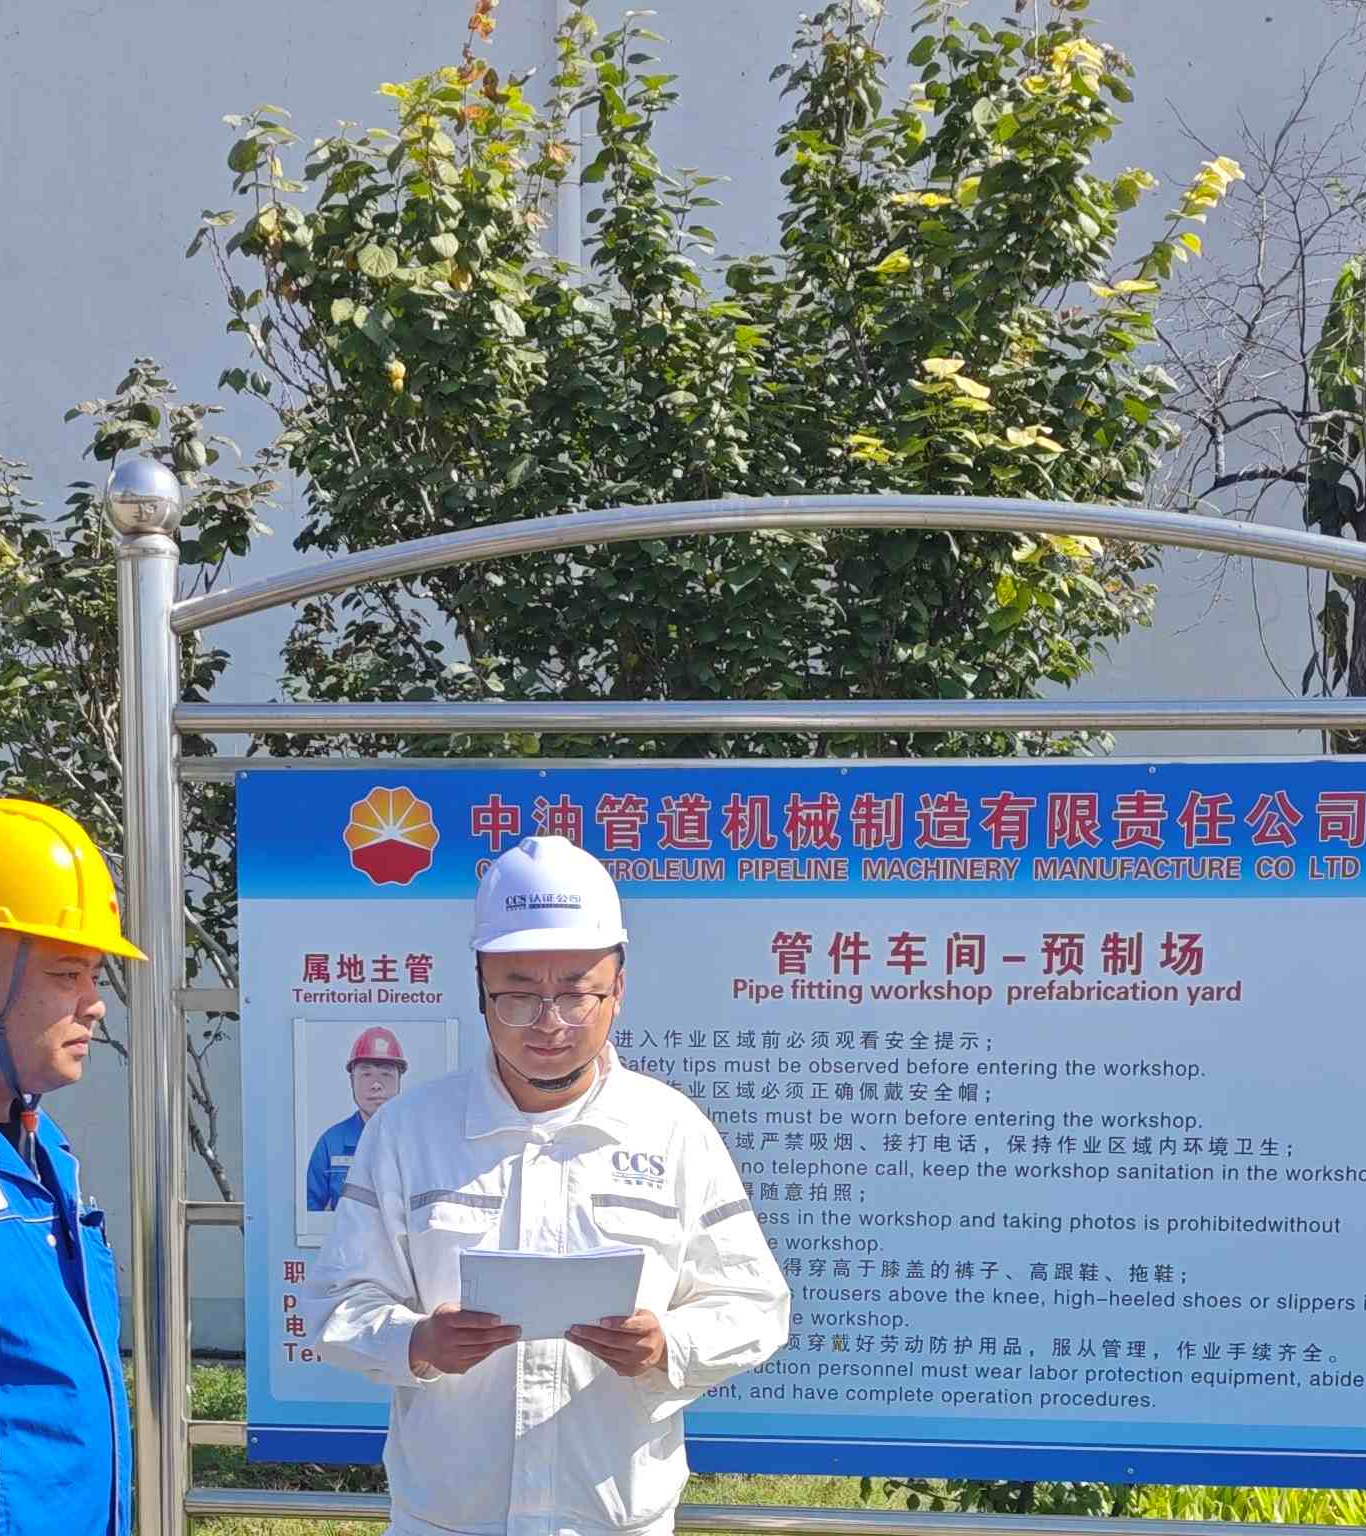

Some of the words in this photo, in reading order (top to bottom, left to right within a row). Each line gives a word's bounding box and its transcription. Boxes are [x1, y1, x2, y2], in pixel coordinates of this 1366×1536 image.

[602, 857, 724, 881] TROLEUM
[738, 857, 848, 881] PIPELINE
[862, 857, 1021, 881] MACHINERY
[1033, 856, 1242, 881] MANUFACTURE
[1255, 857, 1294, 881] CO
[1308, 856, 1362, 880] LTD
[301, 953, 434, 985] 属地主管
[292, 988, 375, 1004] Territorial
[377, 988, 443, 1004] Director
[733, 978, 784, 1004] Pipe
[790, 978, 864, 1005] fitting
[870, 978, 994, 1006] workshop
[1006, 979, 1178, 1006] prefabrication
[1186, 981, 1243, 1006] yard
[617, 1056, 676, 1079] Safety
[682, 1056, 717, 1081] tips
[723, 1057, 771, 1074] must
[778, 1056, 802, 1074] be
[809, 1056, 900, 1075] observed
[906, 1057, 970, 1075] before
[976, 1058, 1058, 1082] entering
[1065, 1059, 1096, 1076] the
[1103, 1059, 1206, 1081] workshop.
[708, 1107, 758, 1125] lmets
[765, 1108, 813, 1125] must
[819, 1107, 843, 1125] be
[850, 1111, 898, 1125] worn
[904, 1108, 968, 1125] before
[974, 1109, 1056, 1133] entering
[1062, 1110, 1094, 1128] the
[1101, 1110, 1204, 1133] workshop.
[611, 1150, 666, 1176] CCS
[741, 1162, 765, 1176] no
[771, 1159, 868, 1182] telephone
[874, 1159, 915, 1180] call,
[922, 1160, 971, 1182] keep
[976, 1161, 1008, 1179] the
[1013, 1161, 1110, 1186] workshop
[1115, 1163, 1215, 1182] sanitation
[1222, 1163, 1240, 1182] in
[1246, 1164, 1279, 1183] the
[797, 1208, 820, 1226] in
[821, 1208, 853, 1226] the
[858, 1208, 952, 1234] workshop
[959, 1211, 996, 1229] and
[1003, 1211, 1062, 1235] taking
[1069, 1214, 1137, 1236] photos
[1143, 1214, 1160, 1231] is
[1167, 1214, 1341, 1237] prohibitedwithout
[785, 1235, 884, 1258] workshop.
[802, 1284, 882, 1302] trousers
[888, 1286, 949, 1304] above
[954, 1288, 986, 1304] the
[991, 1288, 1047, 1308] knee,
[1182, 1291, 1243, 1309] shoes
[1250, 1296, 1271, 1309] or
[1276, 1292, 1356, 1313] slippers
[811, 1308, 910, 1330] workshop.
[818, 1361, 914, 1384] personnel
[921, 1363, 968, 1379] must
[975, 1367, 1023, 1380] wear
[1028, 1365, 1078, 1383] labor
[1085, 1365, 1183, 1387] protection
[1190, 1367, 1302, 1390] equipment,
[1308, 1370, 1365, 1388] abide
[749, 1384, 786, 1401] and
[793, 1384, 839, 1401] have
[846, 1384, 934, 1407] complete
[941, 1386, 1033, 1408] operation
[1040, 1388, 1157, 1410] procedures.
